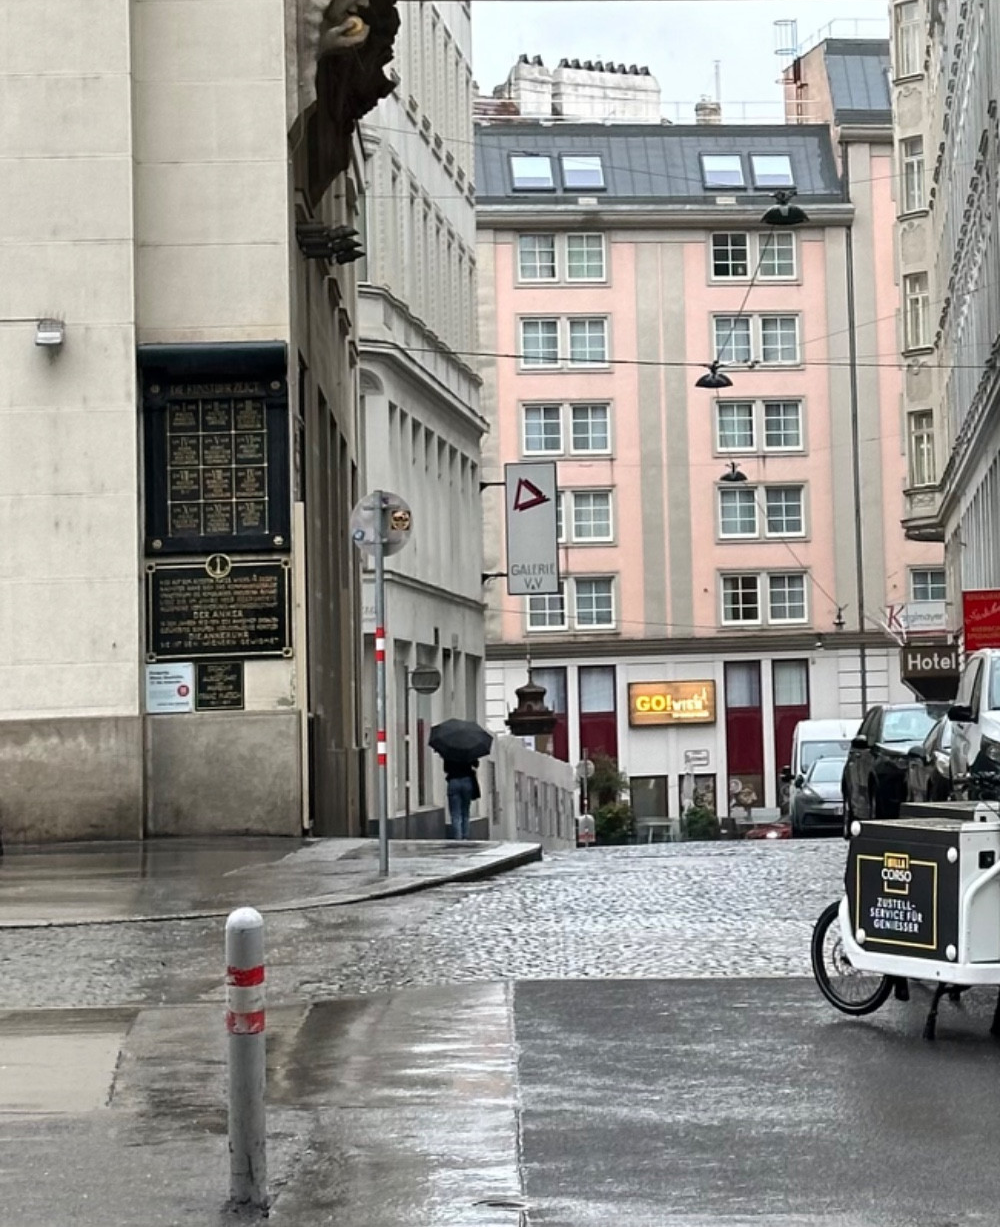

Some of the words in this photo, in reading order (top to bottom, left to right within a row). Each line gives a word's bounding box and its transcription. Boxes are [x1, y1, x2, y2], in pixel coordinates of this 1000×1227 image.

[511, 563, 556, 576] GALERIE
[907, 652, 956, 671] Hotel
[881, 868, 912, 882] CORSO
[877, 897, 916, 910] ZUSTELL-
[870, 907, 904, 921] SERVICE
[906, 910, 922, 923] FÜR
